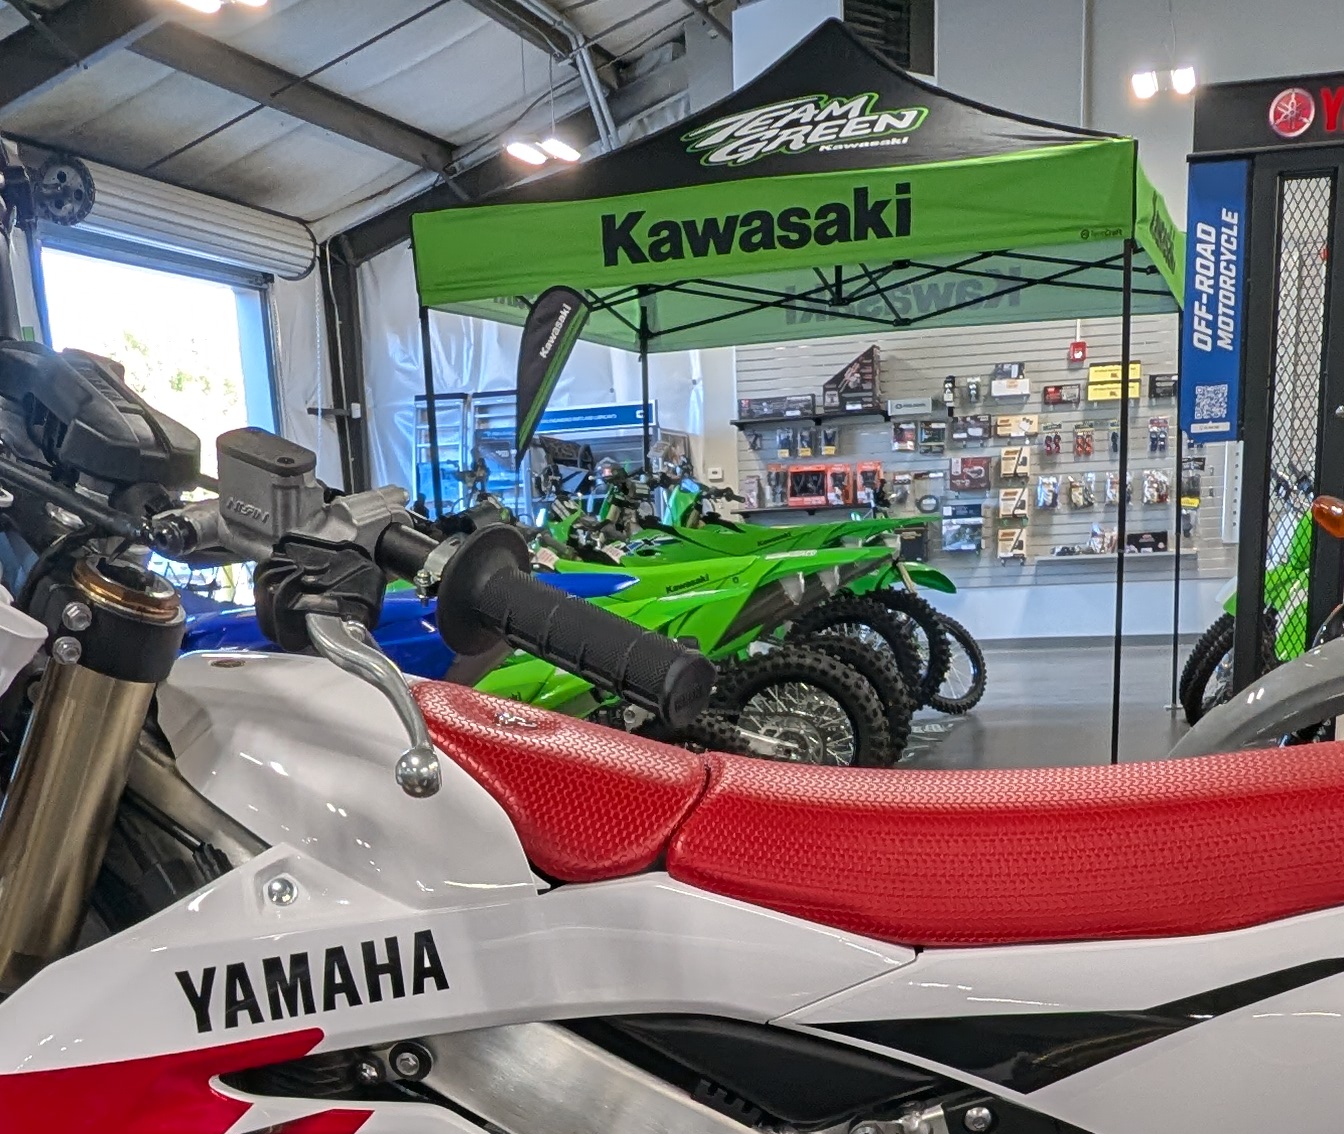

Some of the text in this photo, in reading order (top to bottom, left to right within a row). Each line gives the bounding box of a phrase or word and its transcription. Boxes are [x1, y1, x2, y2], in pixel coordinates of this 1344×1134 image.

[688, 95, 868, 148] TEAM
[708, 110, 918, 163] GREEN
[818, 136, 909, 151] Kawasaki
[602, 182, 912, 267] Kawasaki
[1193, 221, 1217, 352] OFF-ROAD
[1216, 207, 1239, 351] MOTORCYCLE
[540, 303, 572, 359] Kawasaki
[175, 929, 450, 1034] YAMAHA
